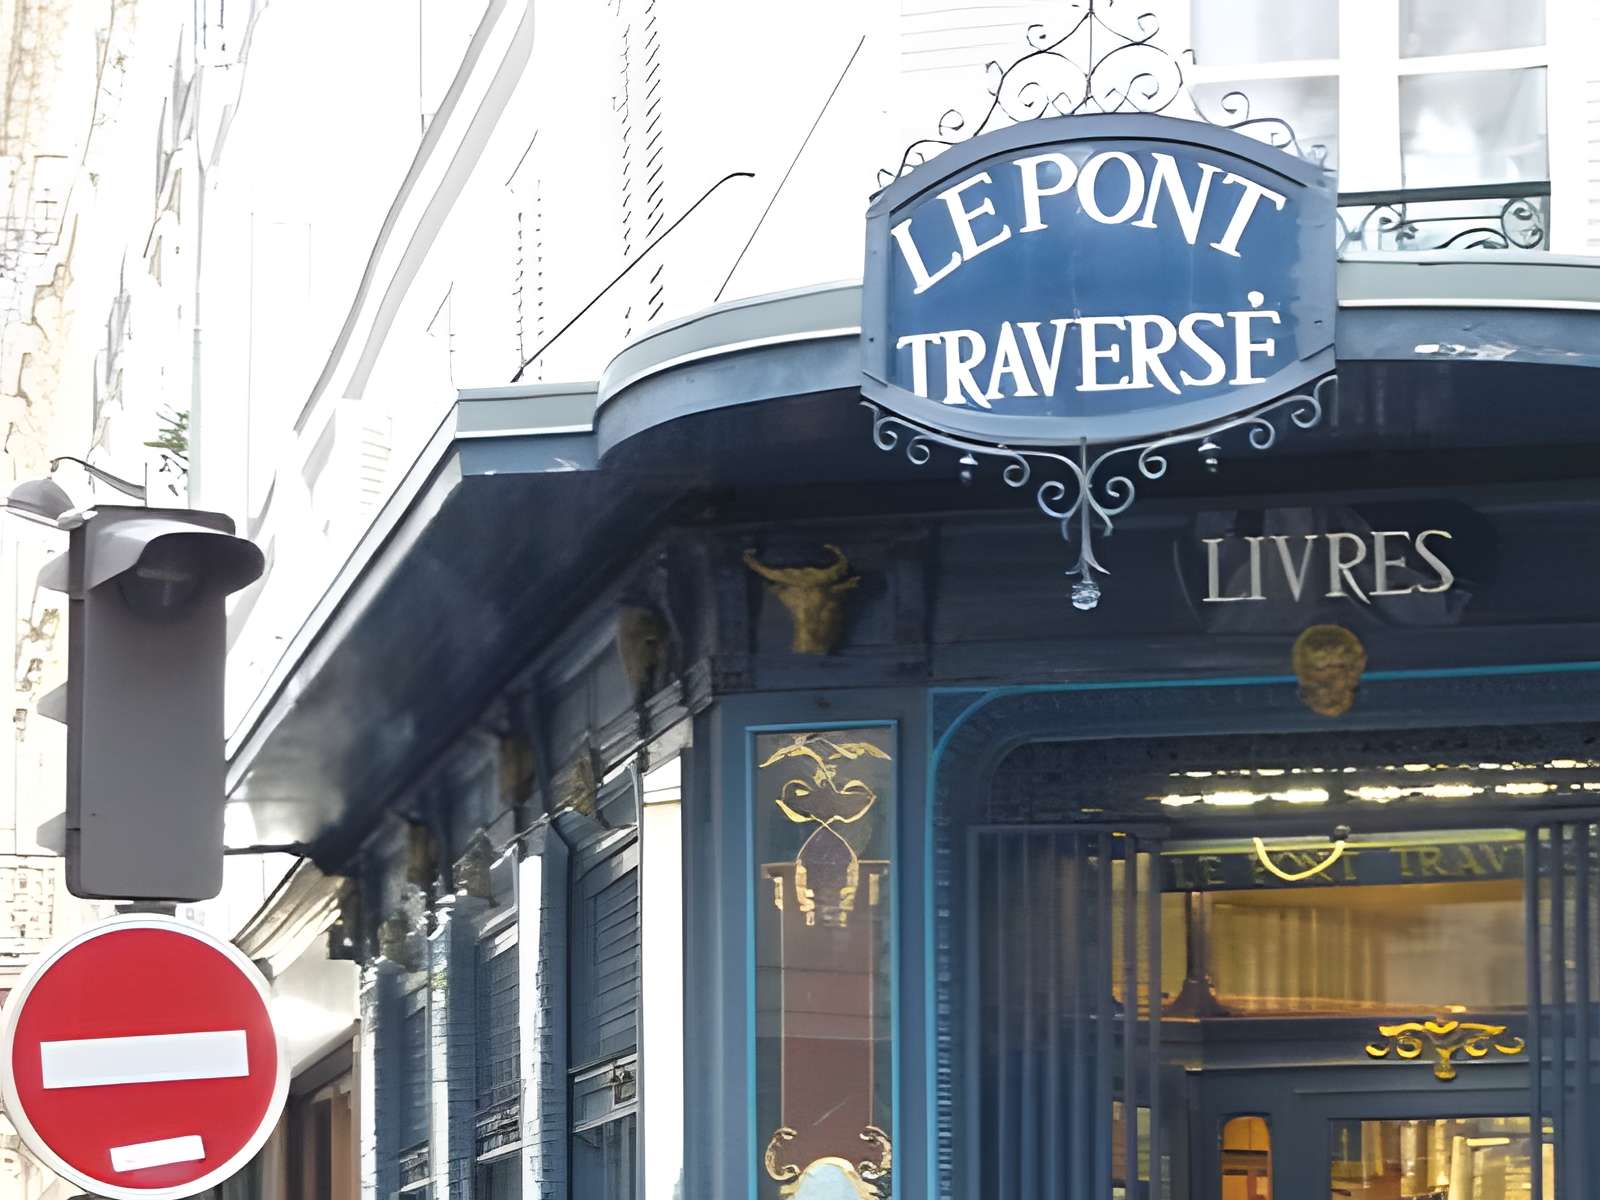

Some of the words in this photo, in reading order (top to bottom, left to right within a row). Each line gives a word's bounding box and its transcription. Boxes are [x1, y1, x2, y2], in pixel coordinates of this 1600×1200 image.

[890, 171, 1012, 295] LE
[1011, 150, 1286, 258] PONT
[896, 290, 1282, 409] TRAVERSÉ
[1201, 529, 1456, 605] LIVRES
[1248, 851, 1360, 885] PNT
